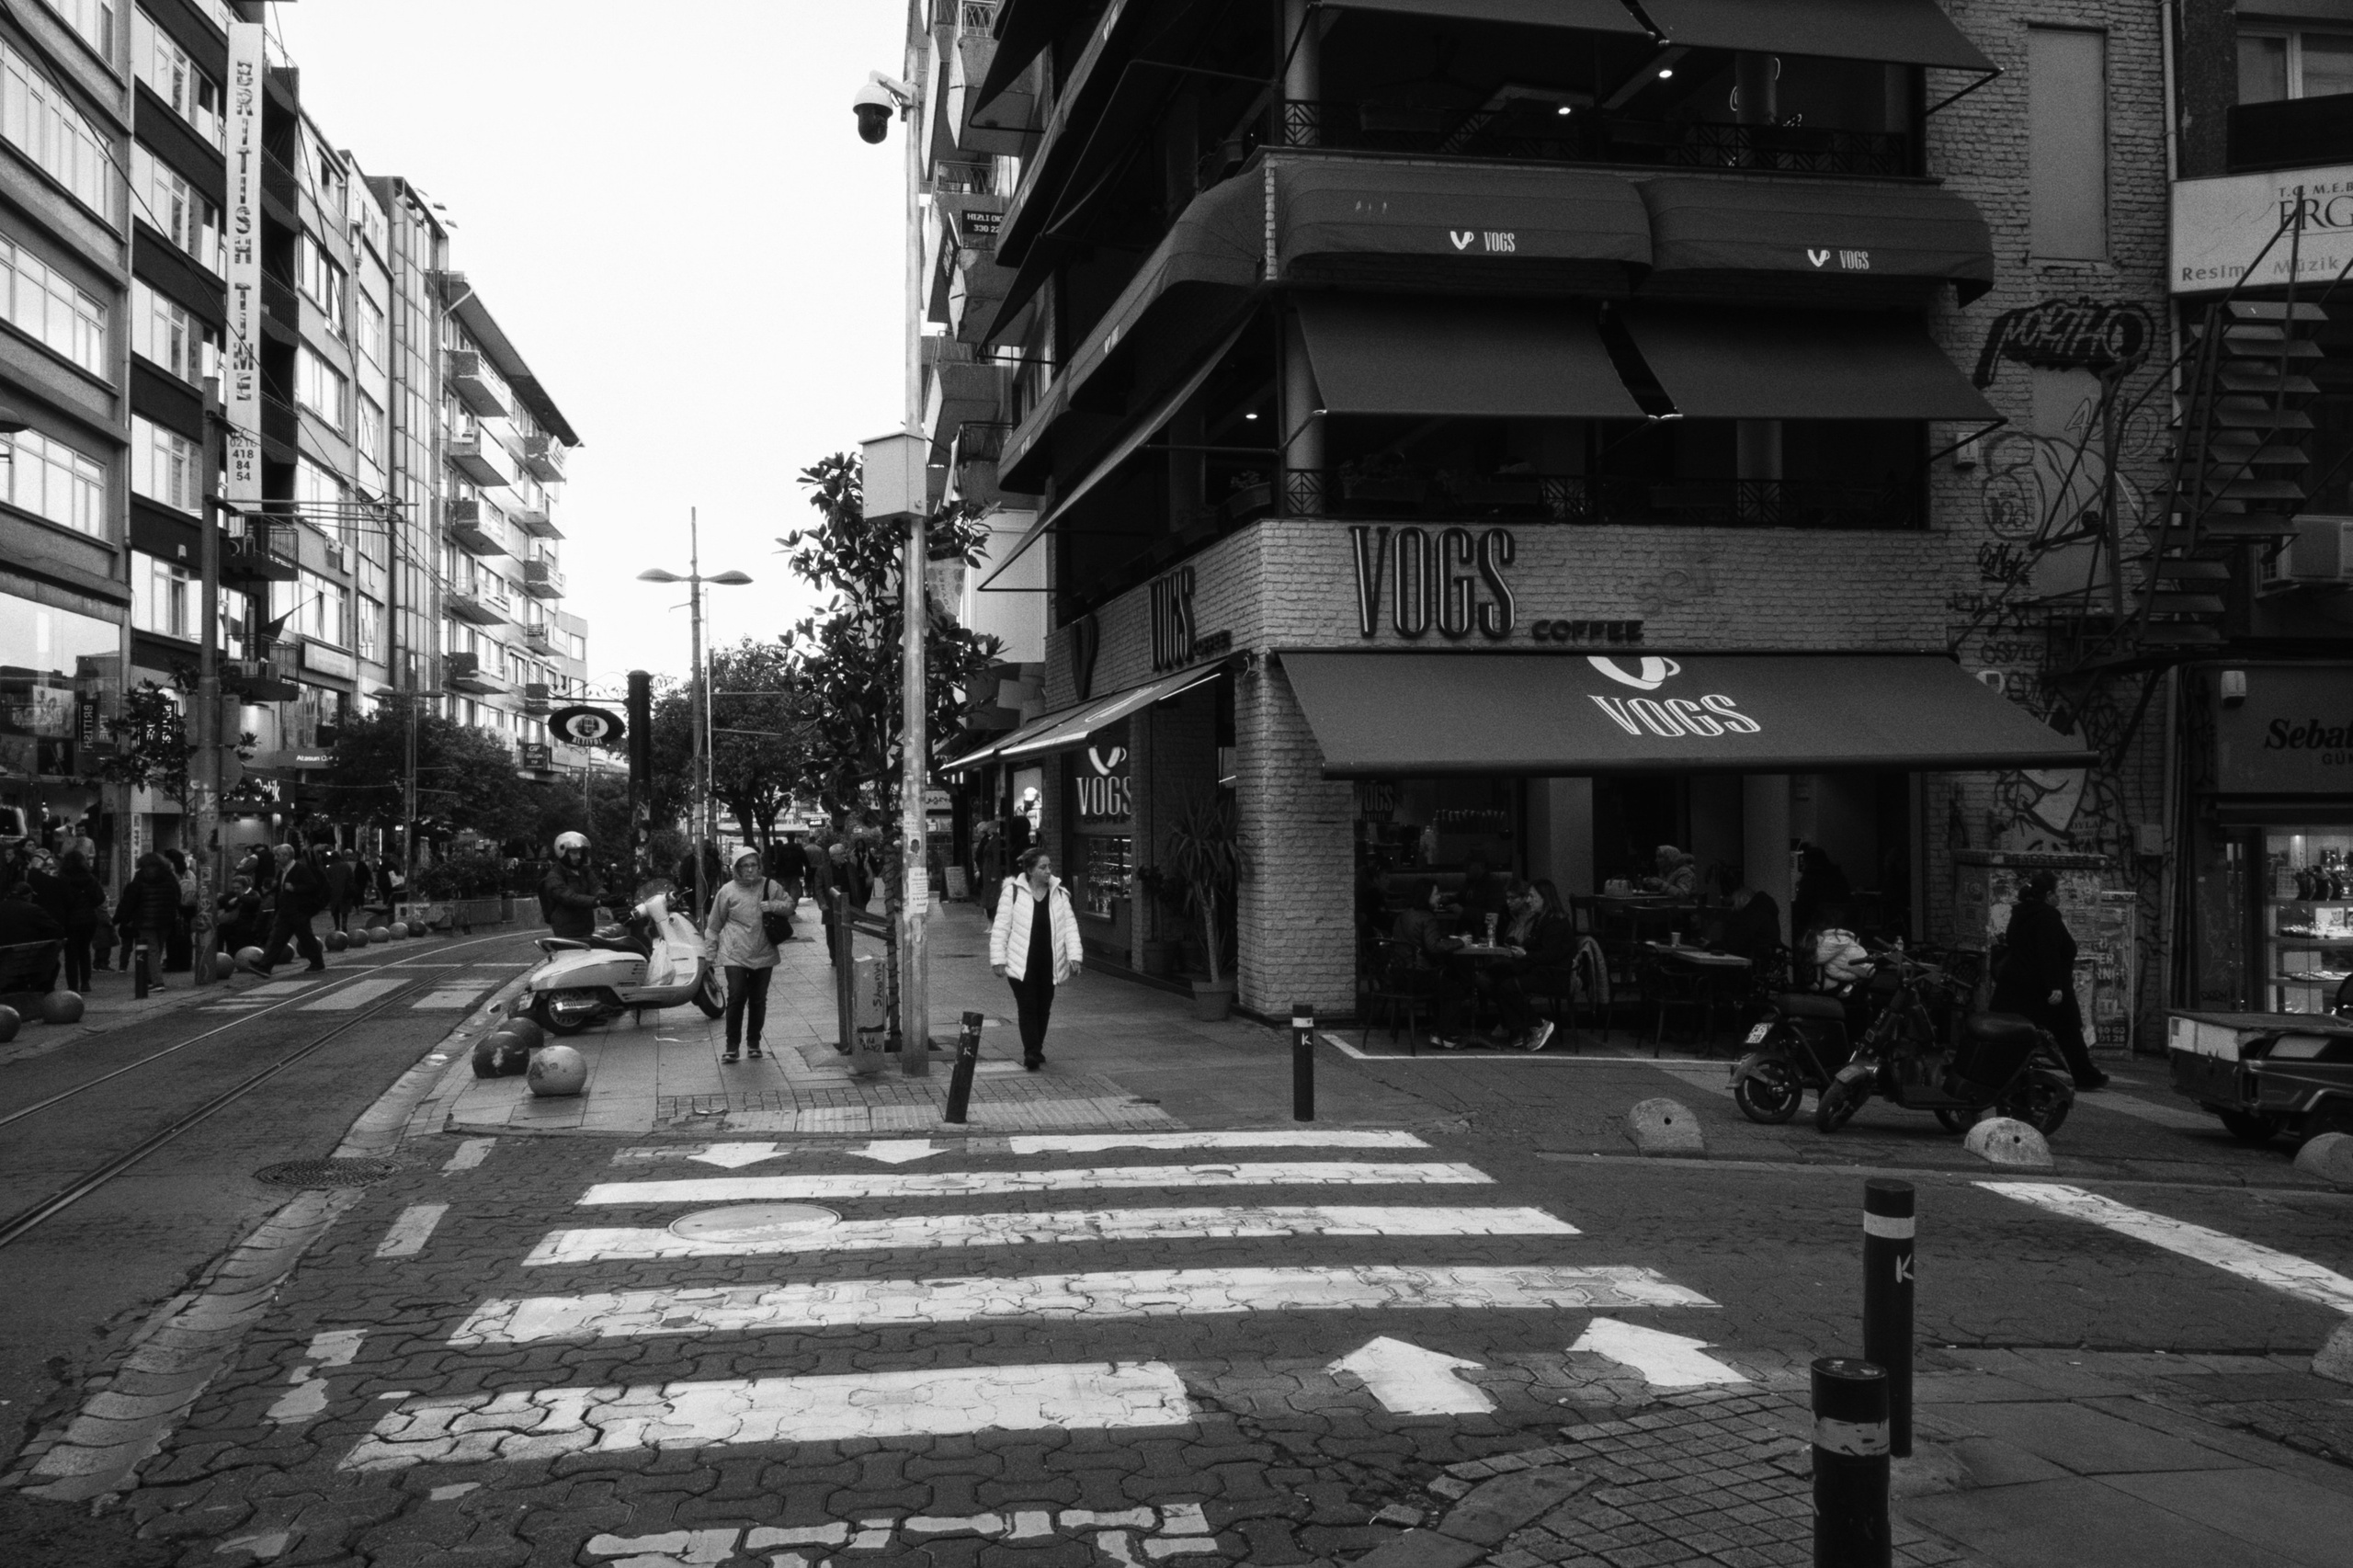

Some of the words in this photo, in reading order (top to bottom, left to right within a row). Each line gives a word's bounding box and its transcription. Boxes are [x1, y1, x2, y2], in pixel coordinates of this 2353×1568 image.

[234, 61, 254, 264] BRITISH
[967, 213, 989, 222] HIZLI
[1483, 231, 1516, 253] VOGS
[1838, 249, 1870, 269] VOGS
[2273, 256, 2340, 275] Müzik
[2182, 265, 2245, 281] Resim
[233, 282, 254, 401] TIME
[233, 449, 255, 459] 418
[235, 460, 251, 470] 84
[236, 472, 251, 481] 54
[1348, 526, 1517, 638] VOGS
[1531, 619, 1645, 642] COFFEE
[1587, 694, 1761, 736] VOGS
[1075, 777, 1131, 815] VOGS
